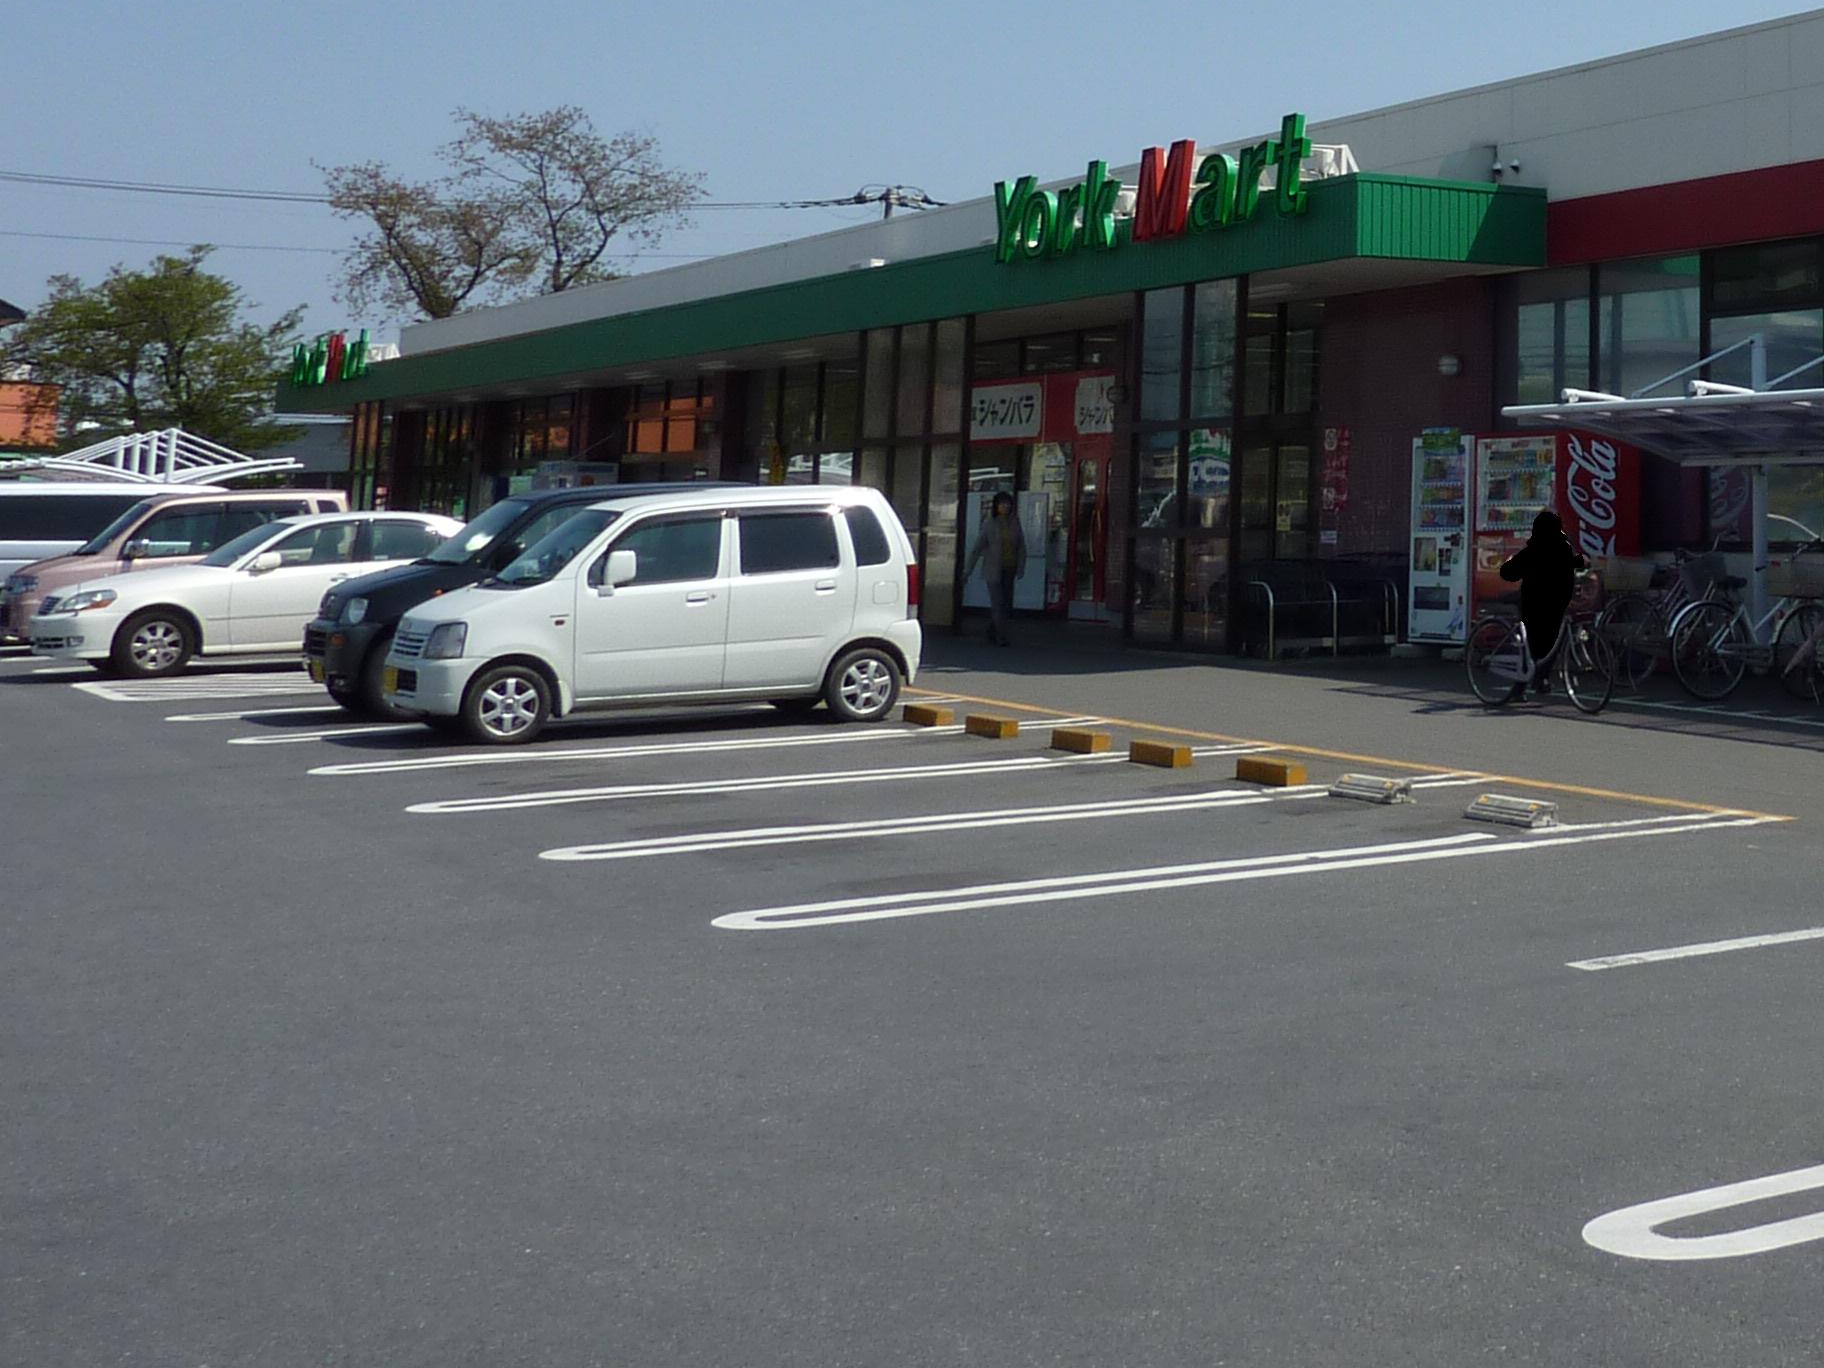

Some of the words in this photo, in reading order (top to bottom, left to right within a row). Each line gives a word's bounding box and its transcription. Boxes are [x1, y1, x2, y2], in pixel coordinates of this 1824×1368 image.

[994, 160, 1122, 263] York
[1132, 112, 1312, 242] Mart
[1080, 407, 1114, 426] シャンバ
